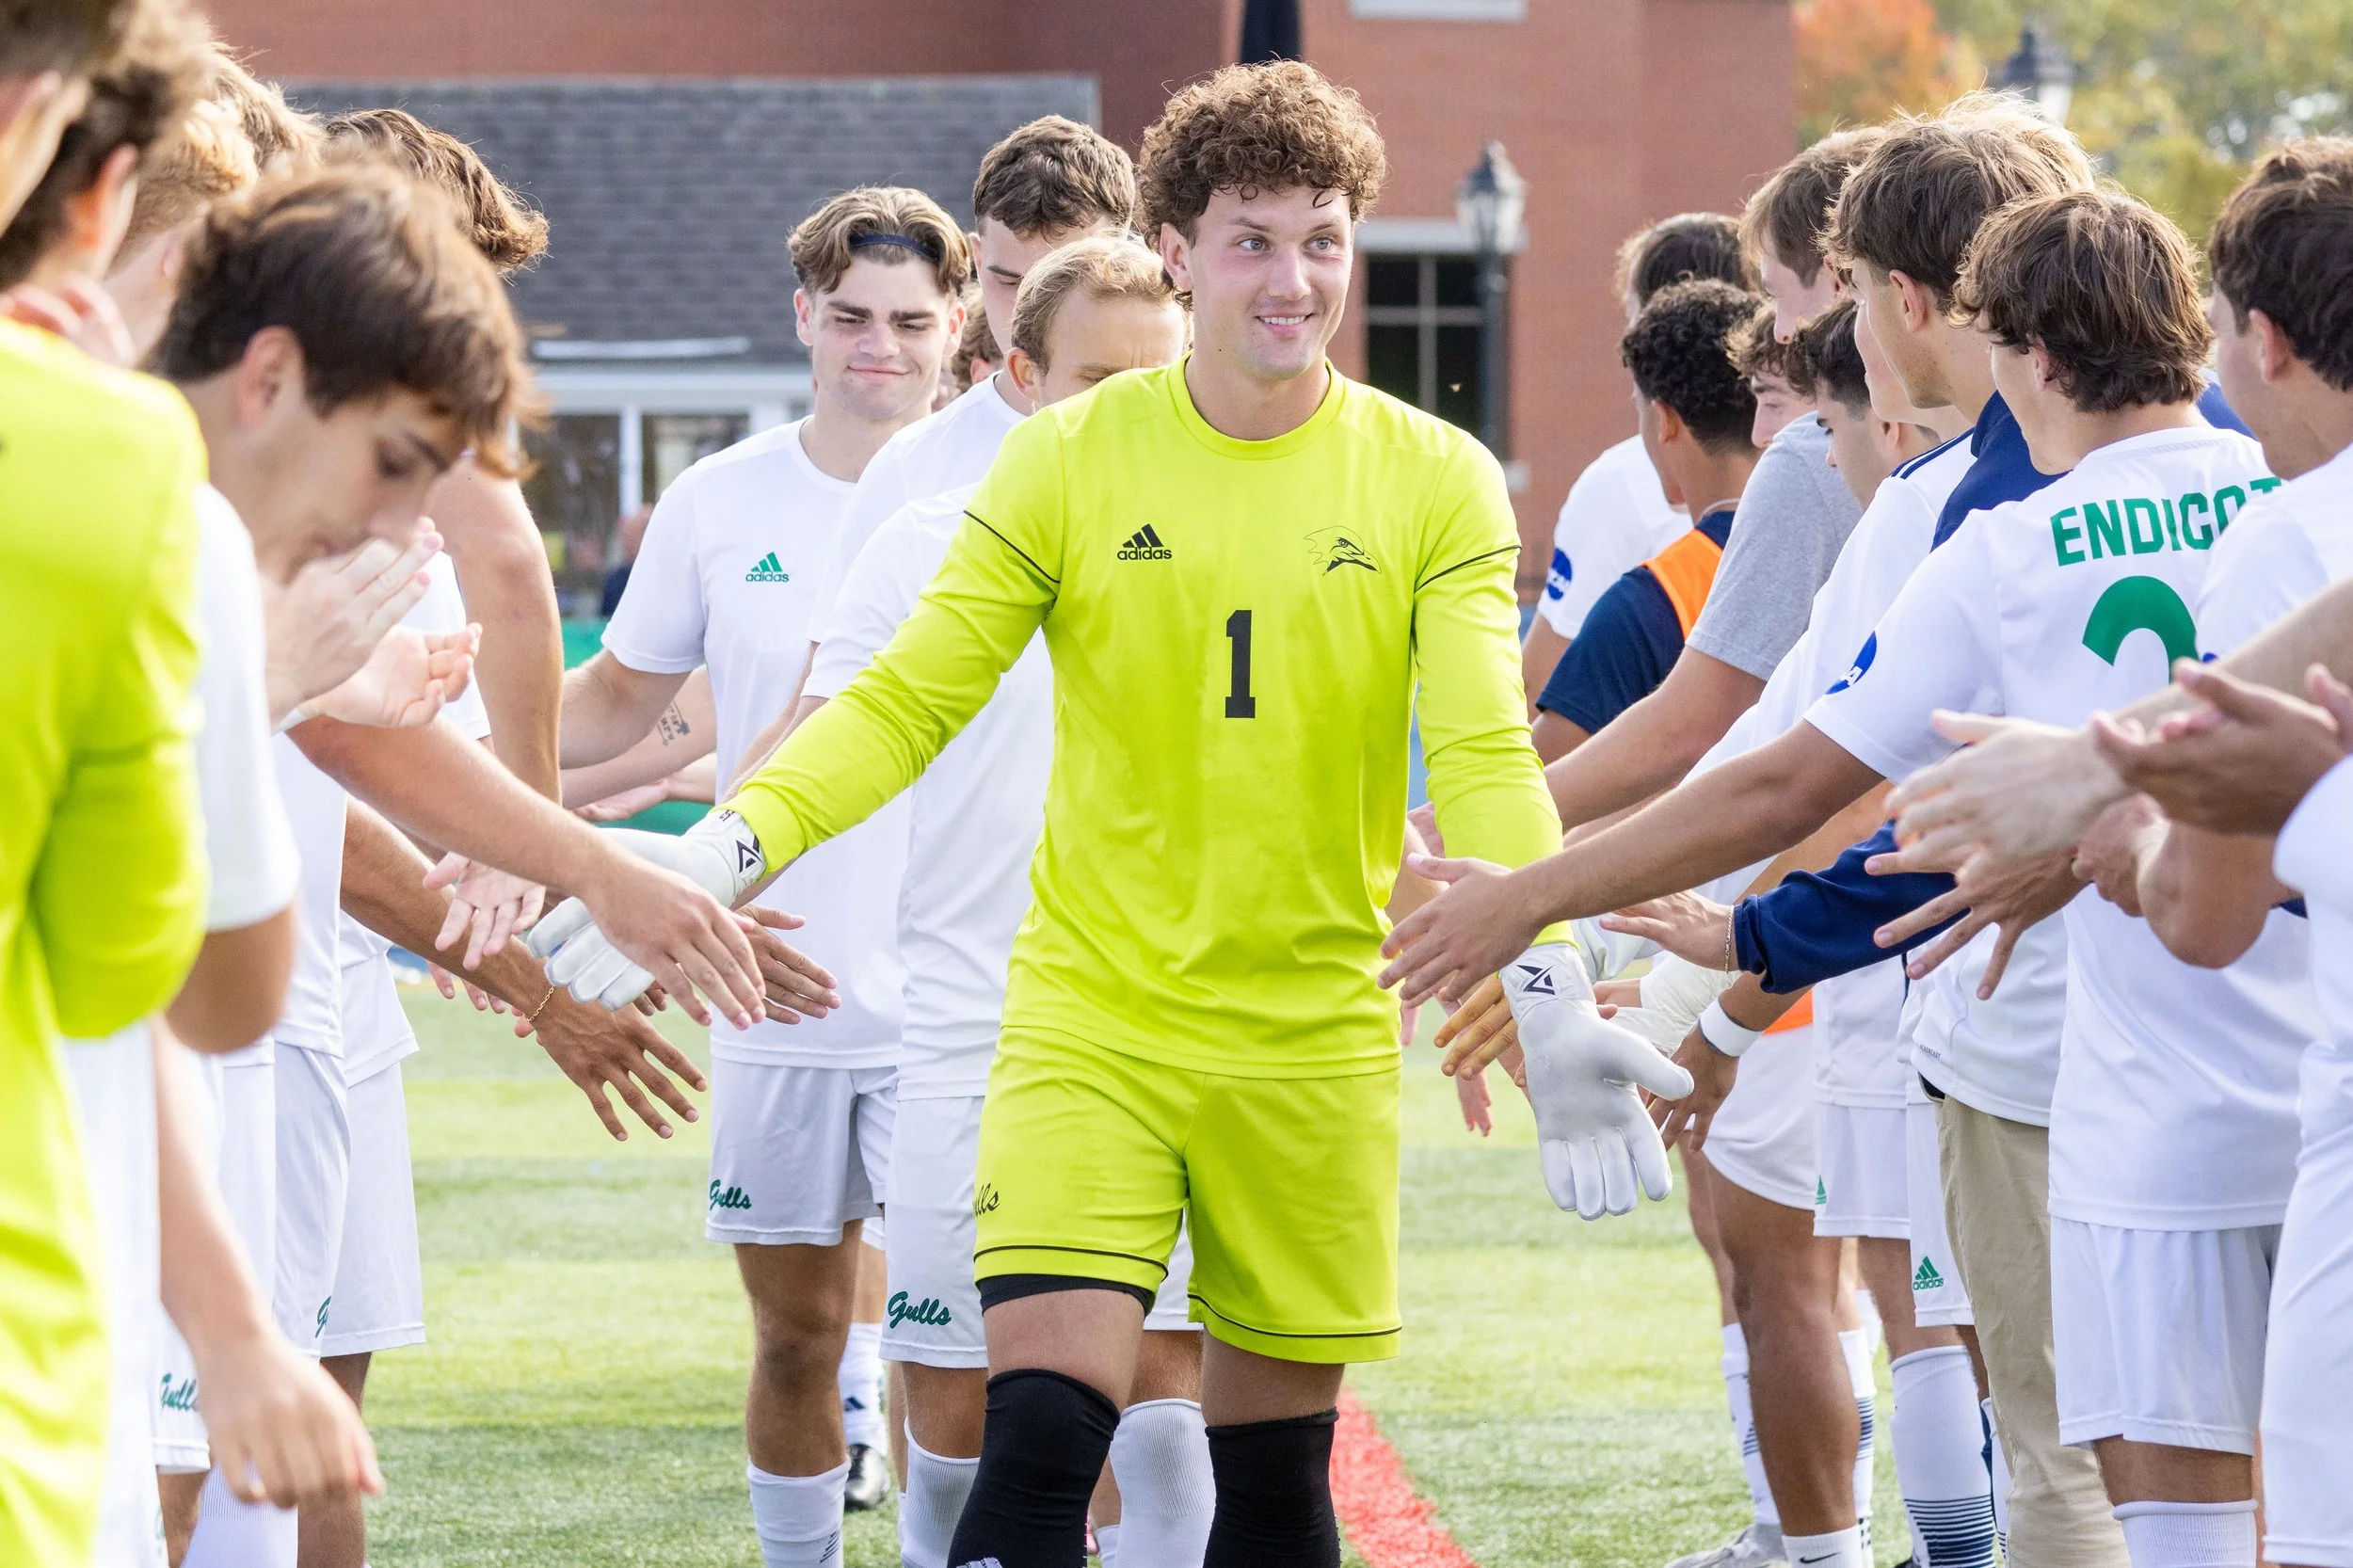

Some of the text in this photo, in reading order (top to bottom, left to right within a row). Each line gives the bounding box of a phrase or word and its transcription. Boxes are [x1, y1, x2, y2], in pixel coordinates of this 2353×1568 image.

[1116, 546, 1173, 560] adidas
[745, 571, 790, 583] adidas
[1225, 610, 1256, 718] 1
[709, 1178, 752, 1211] Gulls
[1913, 1277, 1944, 1290] adidas
[888, 1290, 952, 1329] Gulls
